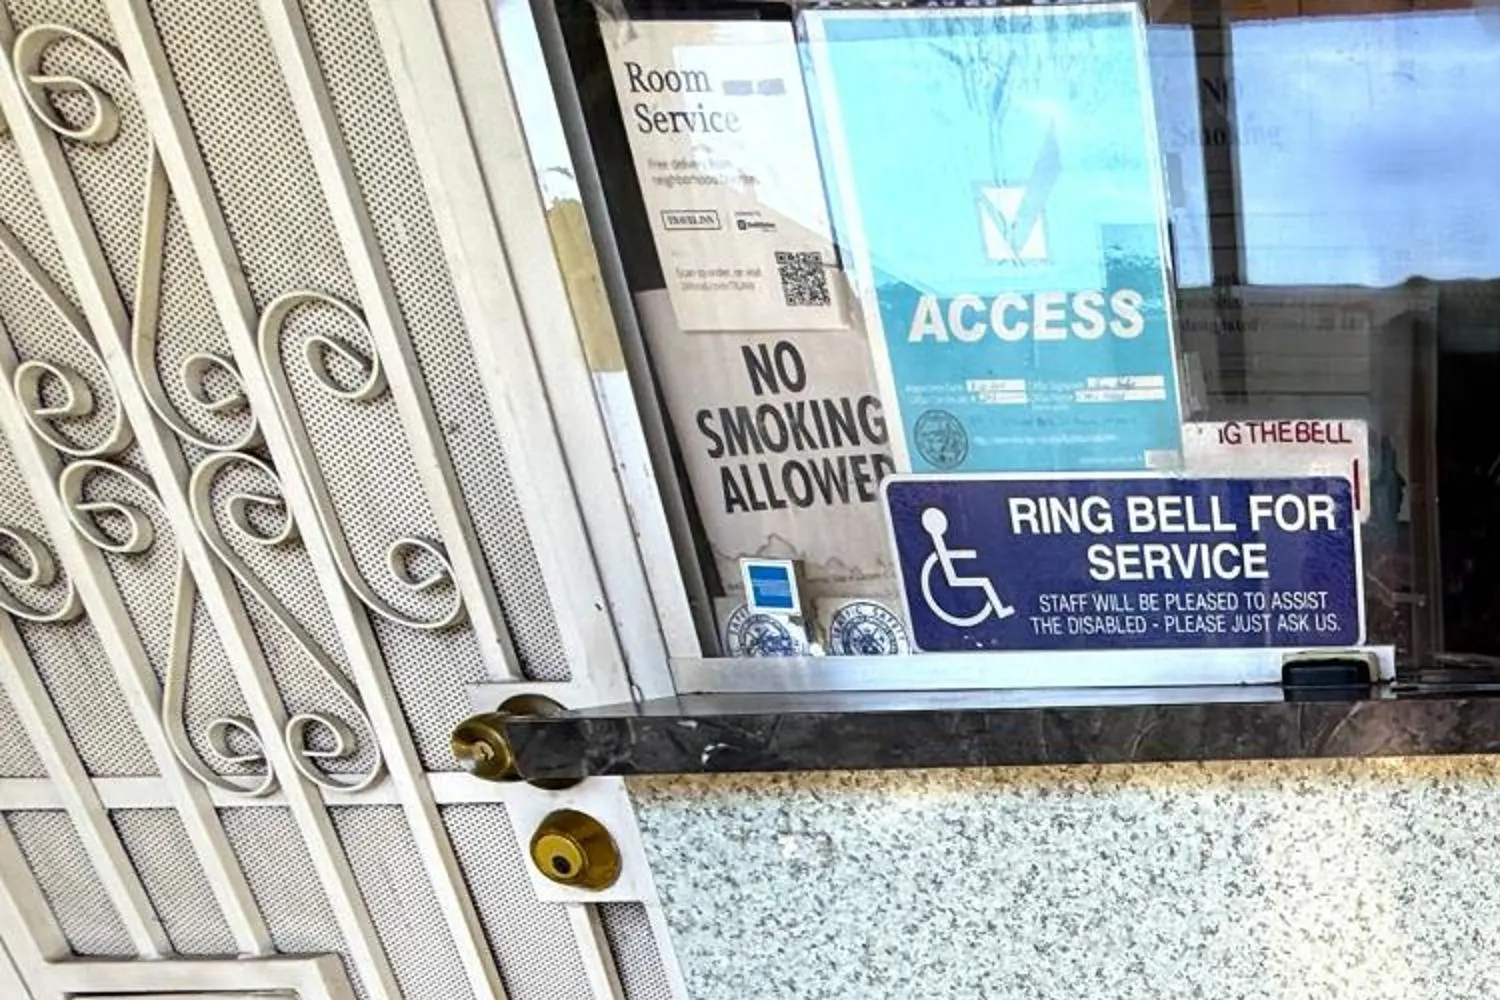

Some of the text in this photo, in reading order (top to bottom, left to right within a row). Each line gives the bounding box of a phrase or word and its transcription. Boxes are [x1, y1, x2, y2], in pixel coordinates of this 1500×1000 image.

[624, 61, 712, 93] Room
[633, 103, 742, 135] Service
[907, 288, 1146, 344] ACCESS
[741, 340, 806, 396] NO
[697, 395, 890, 458] SMOKING
[1245, 422, 1293, 443] THE
[1295, 421, 1353, 443] BELL
[1008, 495, 1337, 534] RING BELL FOR
[1087, 543, 1269, 581] SERVICE
[1039, 591, 1329, 613] STAFF WILL BE PLEASED TO ASSIST
[1030, 617, 1063, 635] THE
[1067, 616, 1147, 634] DISABLED
[1165, 615, 1227, 633] PLEASE
[1231, 615, 1271, 633] JUST
[1277, 614, 1309, 632] ASK
[1315, 614, 1342, 632] US.
